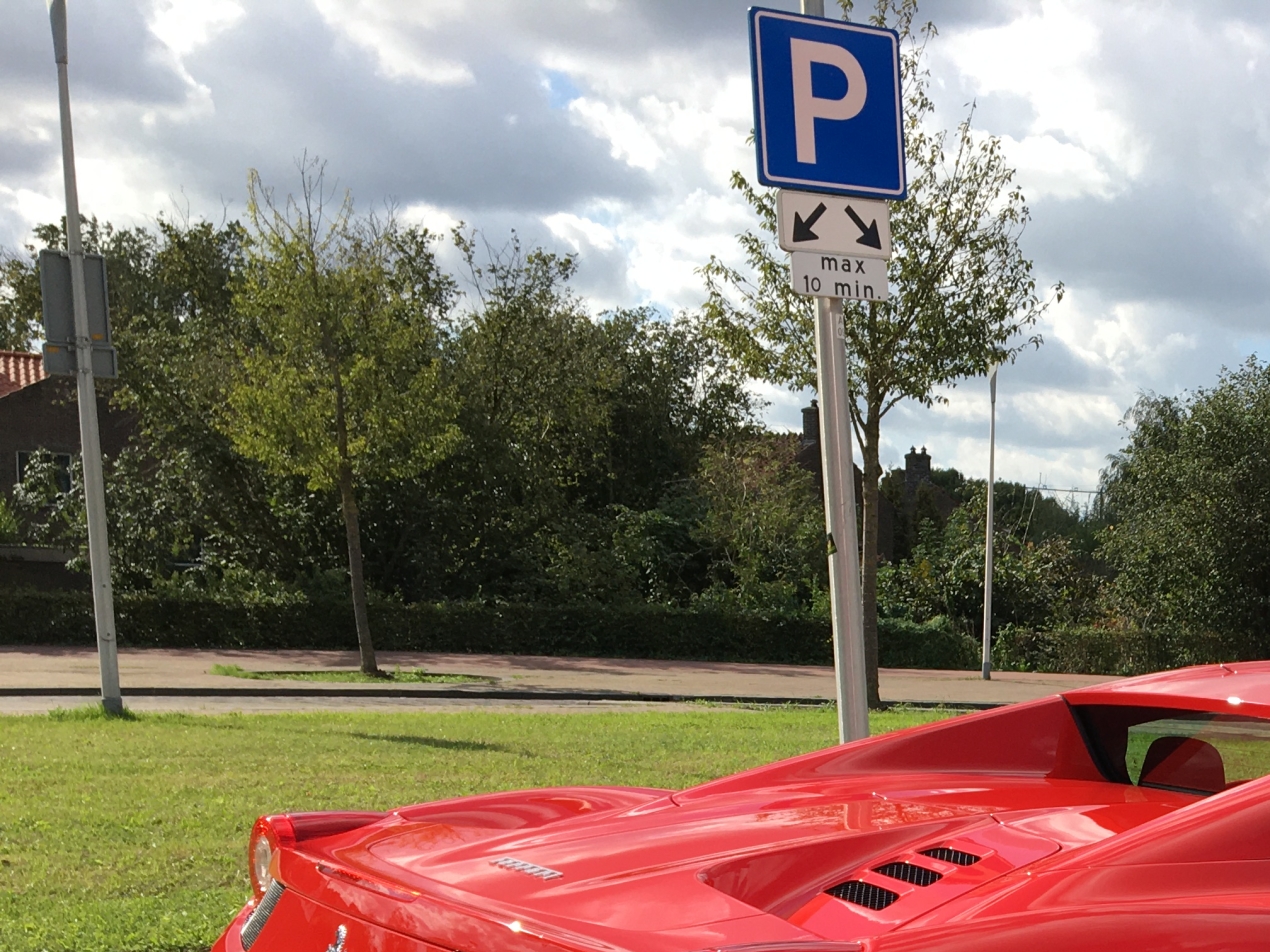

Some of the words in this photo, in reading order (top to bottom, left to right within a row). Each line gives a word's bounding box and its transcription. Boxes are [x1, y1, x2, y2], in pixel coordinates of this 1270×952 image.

[790, 37, 867, 164] P
[821, 256, 866, 274] max
[803, 275, 821, 293] 10
[834, 280, 882, 300] min.
